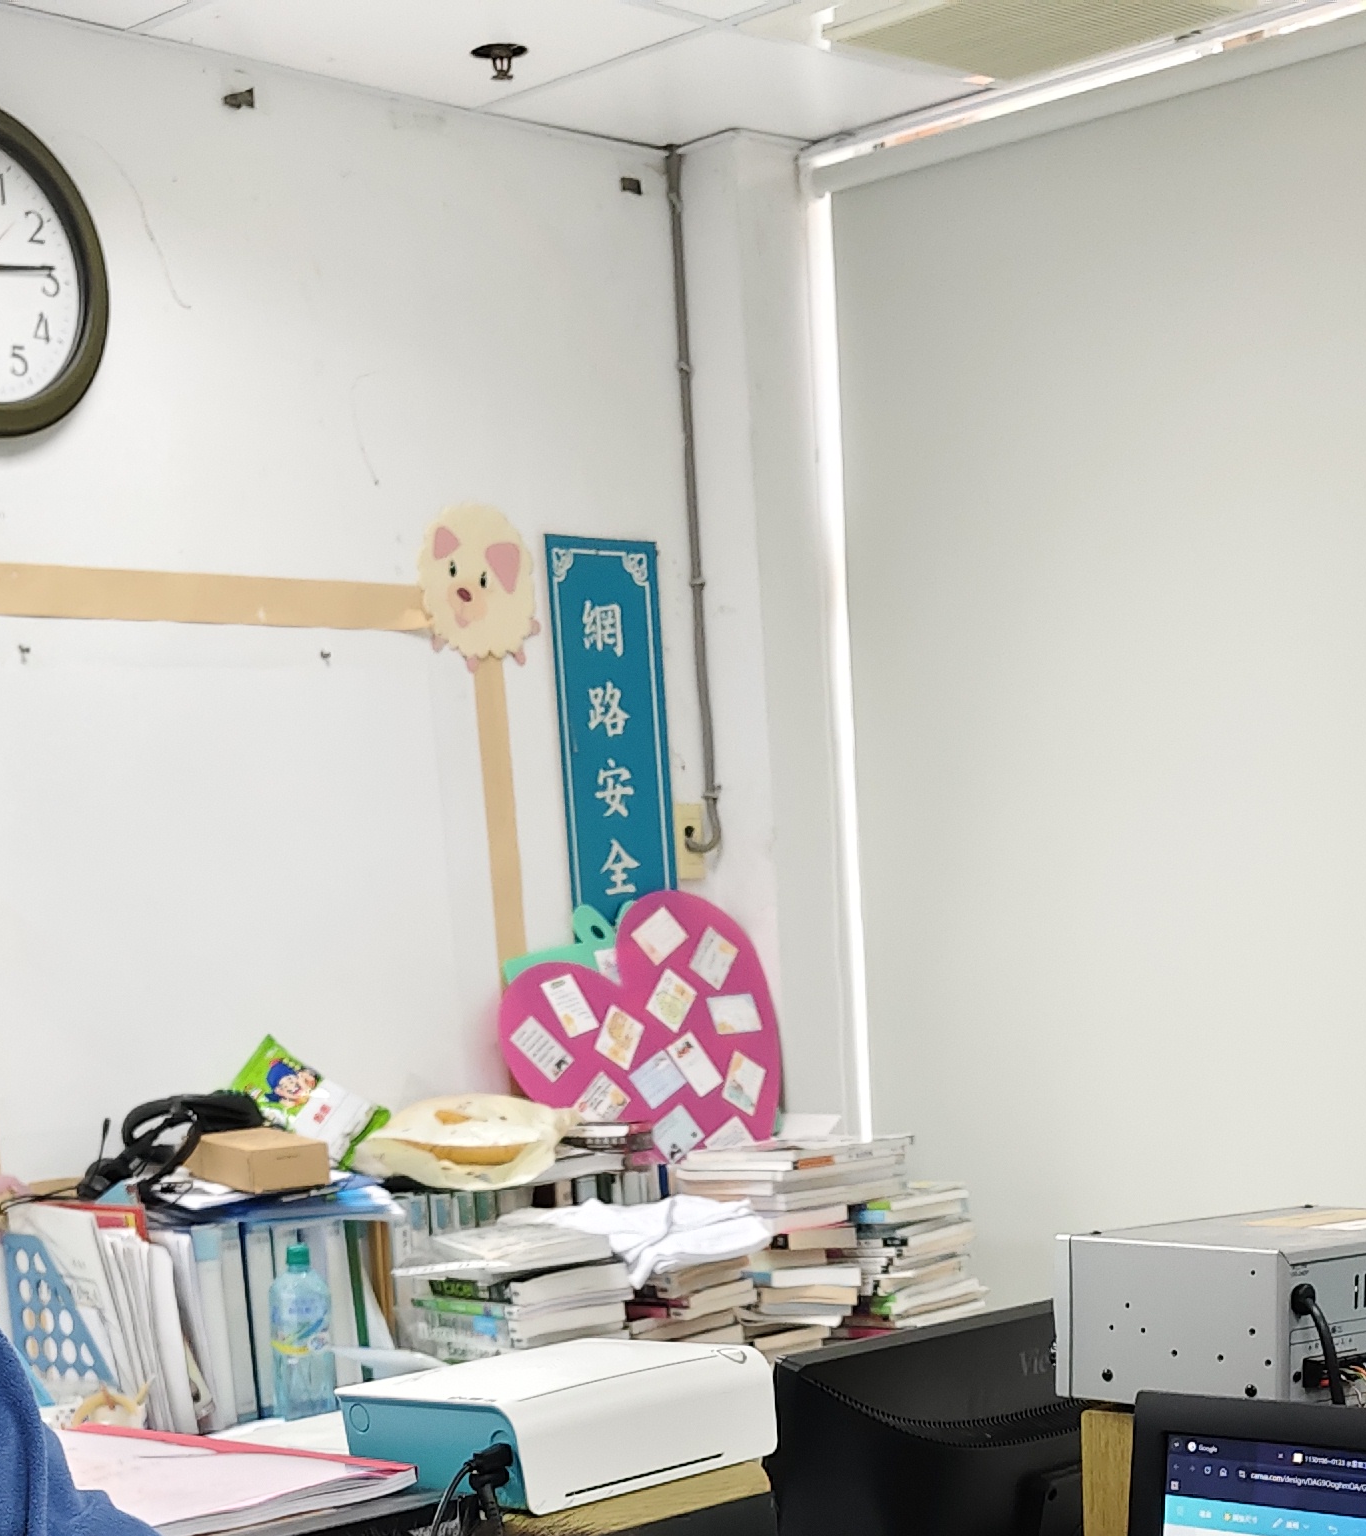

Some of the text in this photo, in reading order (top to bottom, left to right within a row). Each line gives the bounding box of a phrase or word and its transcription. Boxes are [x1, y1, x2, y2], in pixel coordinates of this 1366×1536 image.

[25, 210, 45, 244] 2
[42, 268, 60, 298] 3
[34, 312, 51, 344] 4
[10, 345, 28, 376] 5
[581, 599, 640, 897] 網路安全
